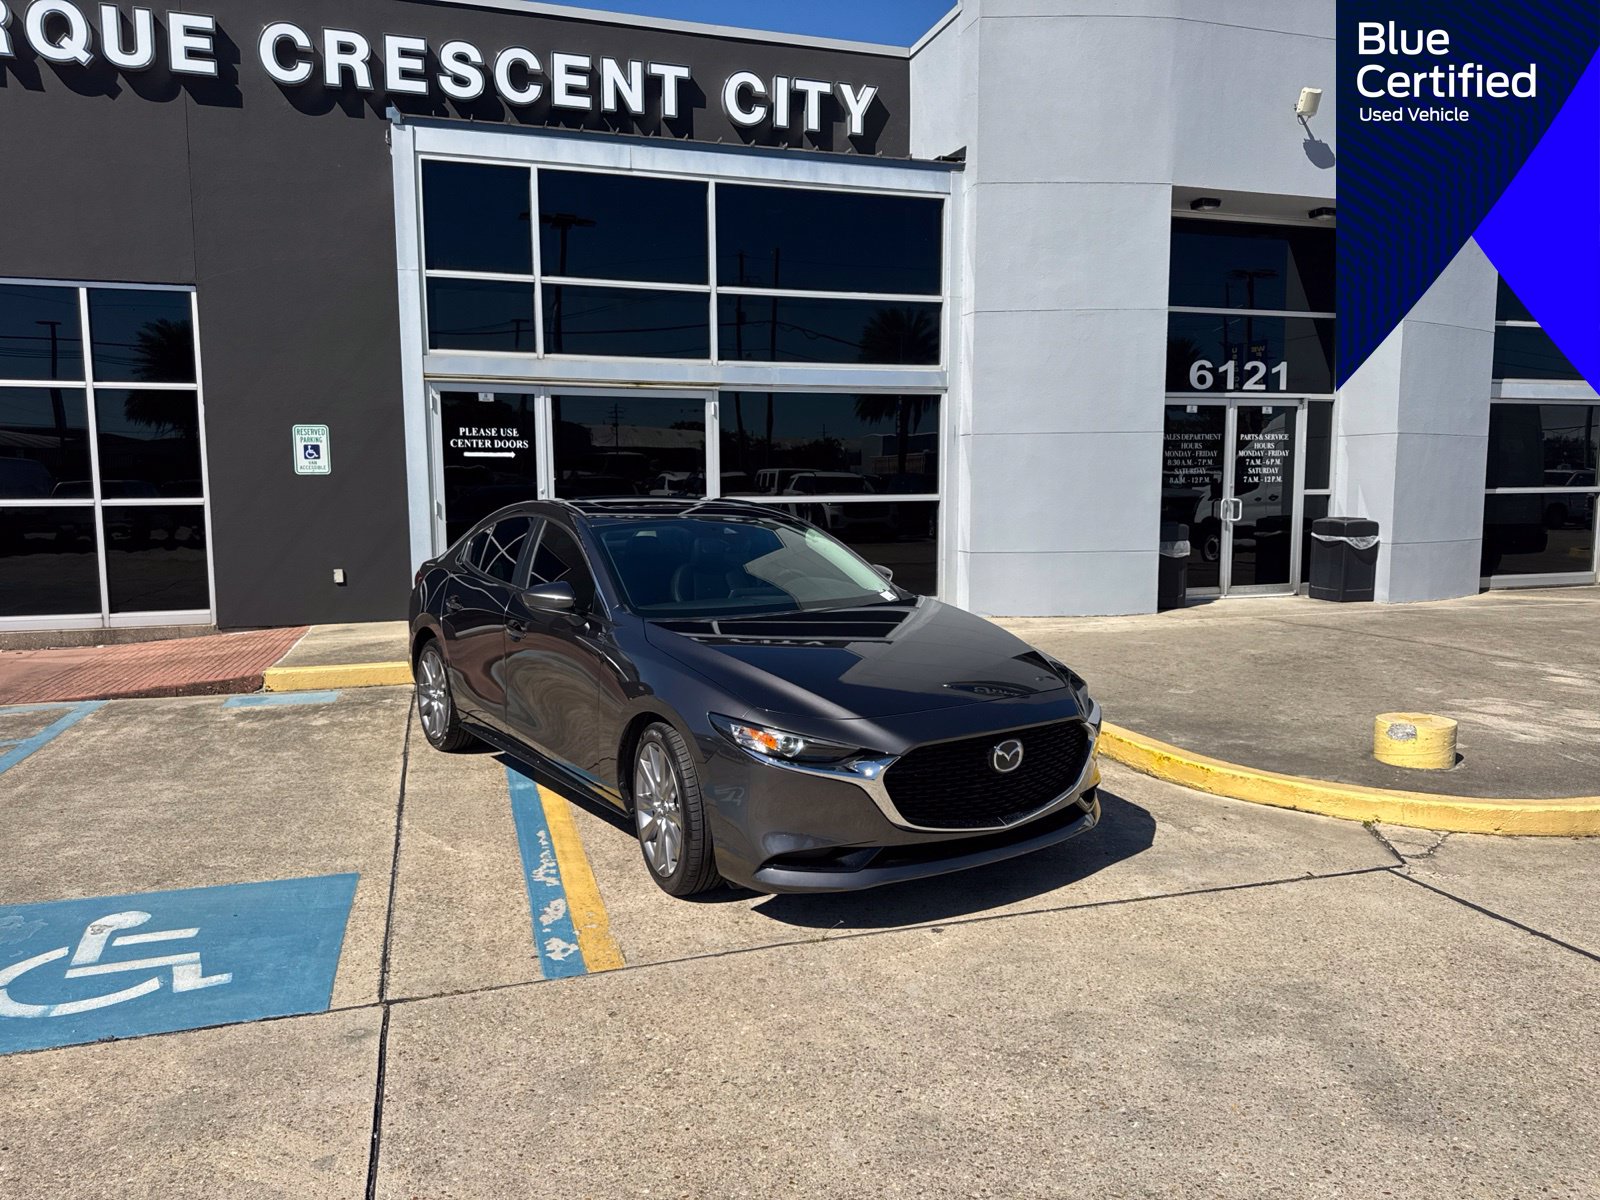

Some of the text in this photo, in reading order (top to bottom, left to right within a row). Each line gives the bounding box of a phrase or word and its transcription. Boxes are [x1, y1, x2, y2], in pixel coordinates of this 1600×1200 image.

[0, 0, 879, 136] QUE CRESCENT CITY
[1188, 359, 1288, 391] 6121
[296, 428, 326, 436] RESERVED
[459, 427, 520, 437] PLEASE USE
[1181, 433, 1222, 441] DEPARTMENT
[1240, 433, 1258, 441] PARTS
[1264, 433, 1290, 441] SERVICE
[450, 438, 529, 449] CENTER DOORS
[1180, 442, 1203, 450] HOURS
[1253, 442, 1275, 450] HOURS
[1174, 467, 1207, 475] SATURDAY
[1247, 467, 1280, 475] SATURDAY
